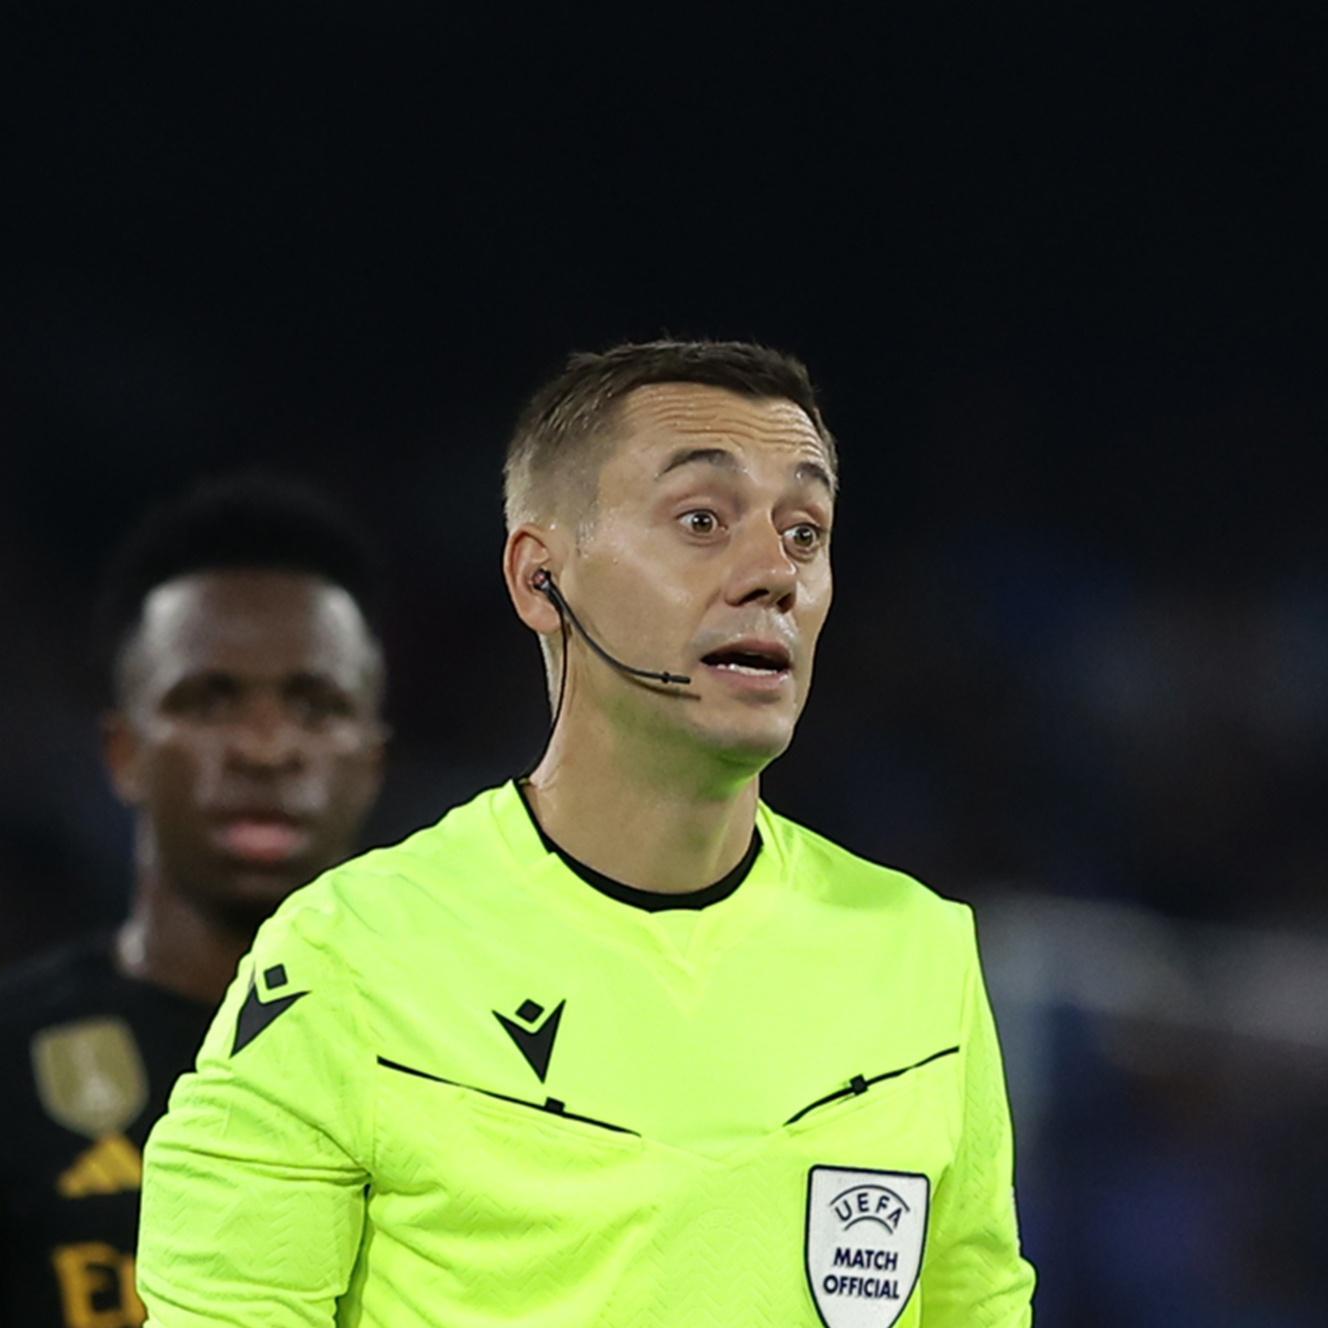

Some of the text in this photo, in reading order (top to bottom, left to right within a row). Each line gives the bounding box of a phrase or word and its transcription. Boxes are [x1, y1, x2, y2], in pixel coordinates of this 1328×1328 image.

[833, 1192, 903, 1229] UEFA
[833, 1247, 898, 1271] MATCH
[823, 1274, 900, 1300] OFFICIAL
